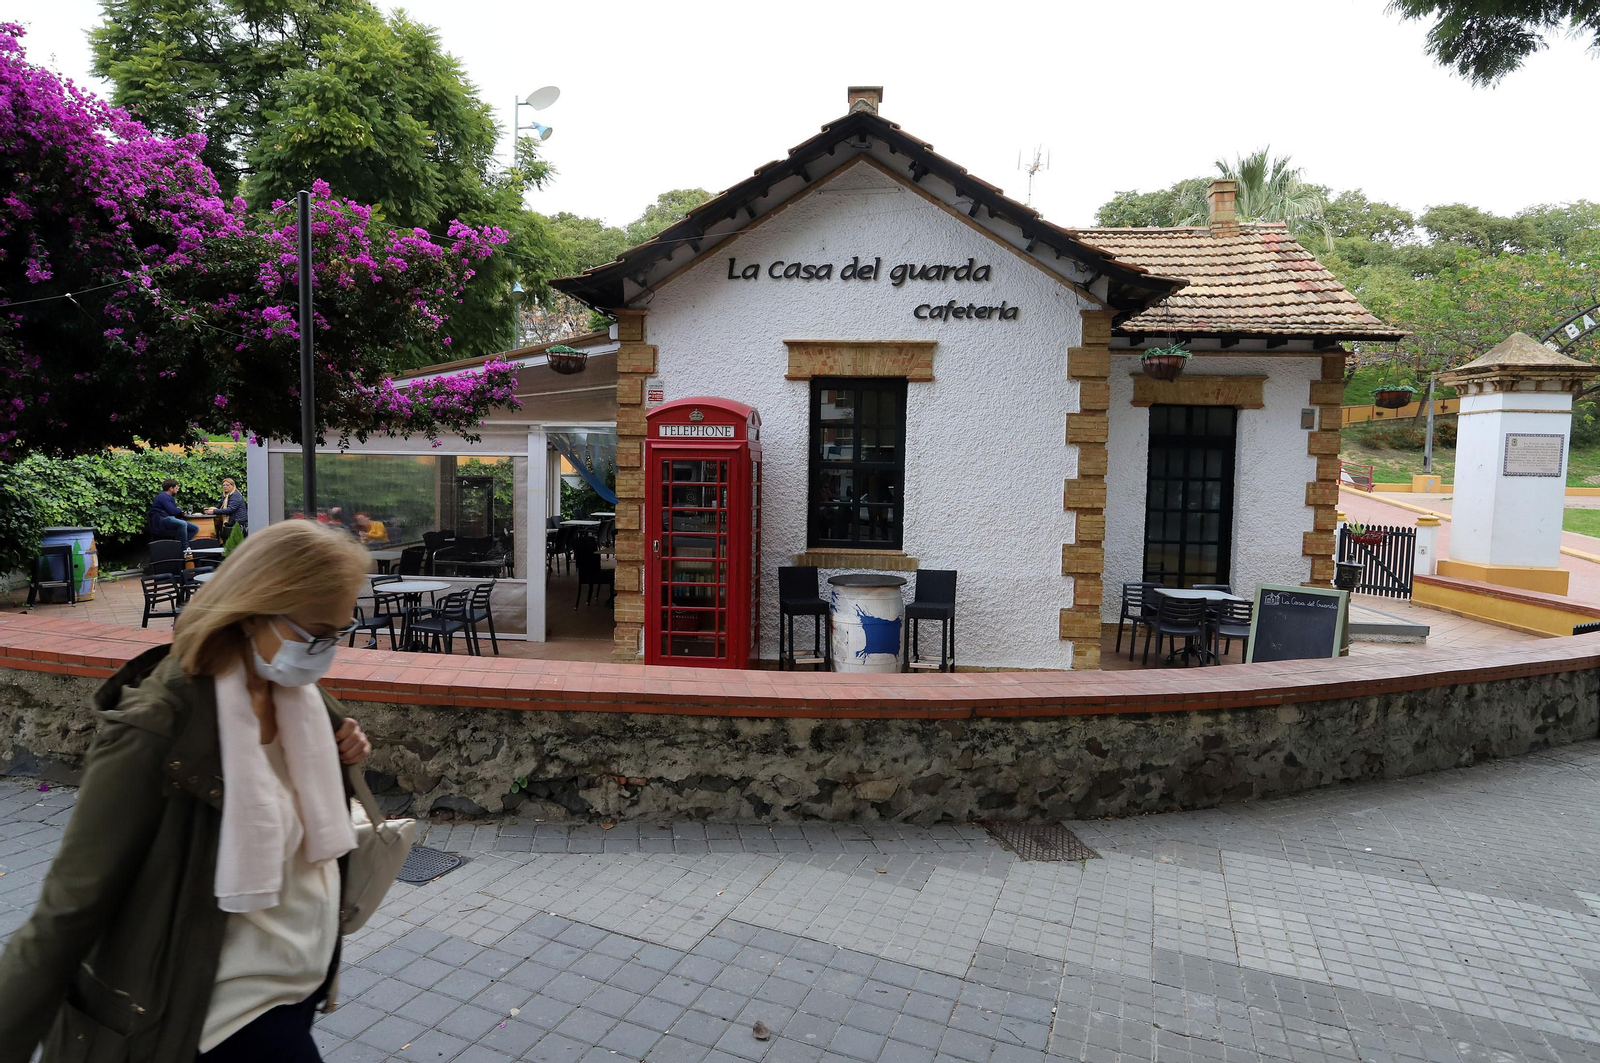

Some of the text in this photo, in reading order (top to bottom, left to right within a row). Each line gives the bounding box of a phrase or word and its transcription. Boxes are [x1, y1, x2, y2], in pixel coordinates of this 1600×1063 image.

[727, 257, 760, 281] La
[839, 256, 881, 281] del
[889, 257, 992, 287] guarda
[661, 425, 732, 437] TELEPHONE
[1282, 597, 1290, 605] La
